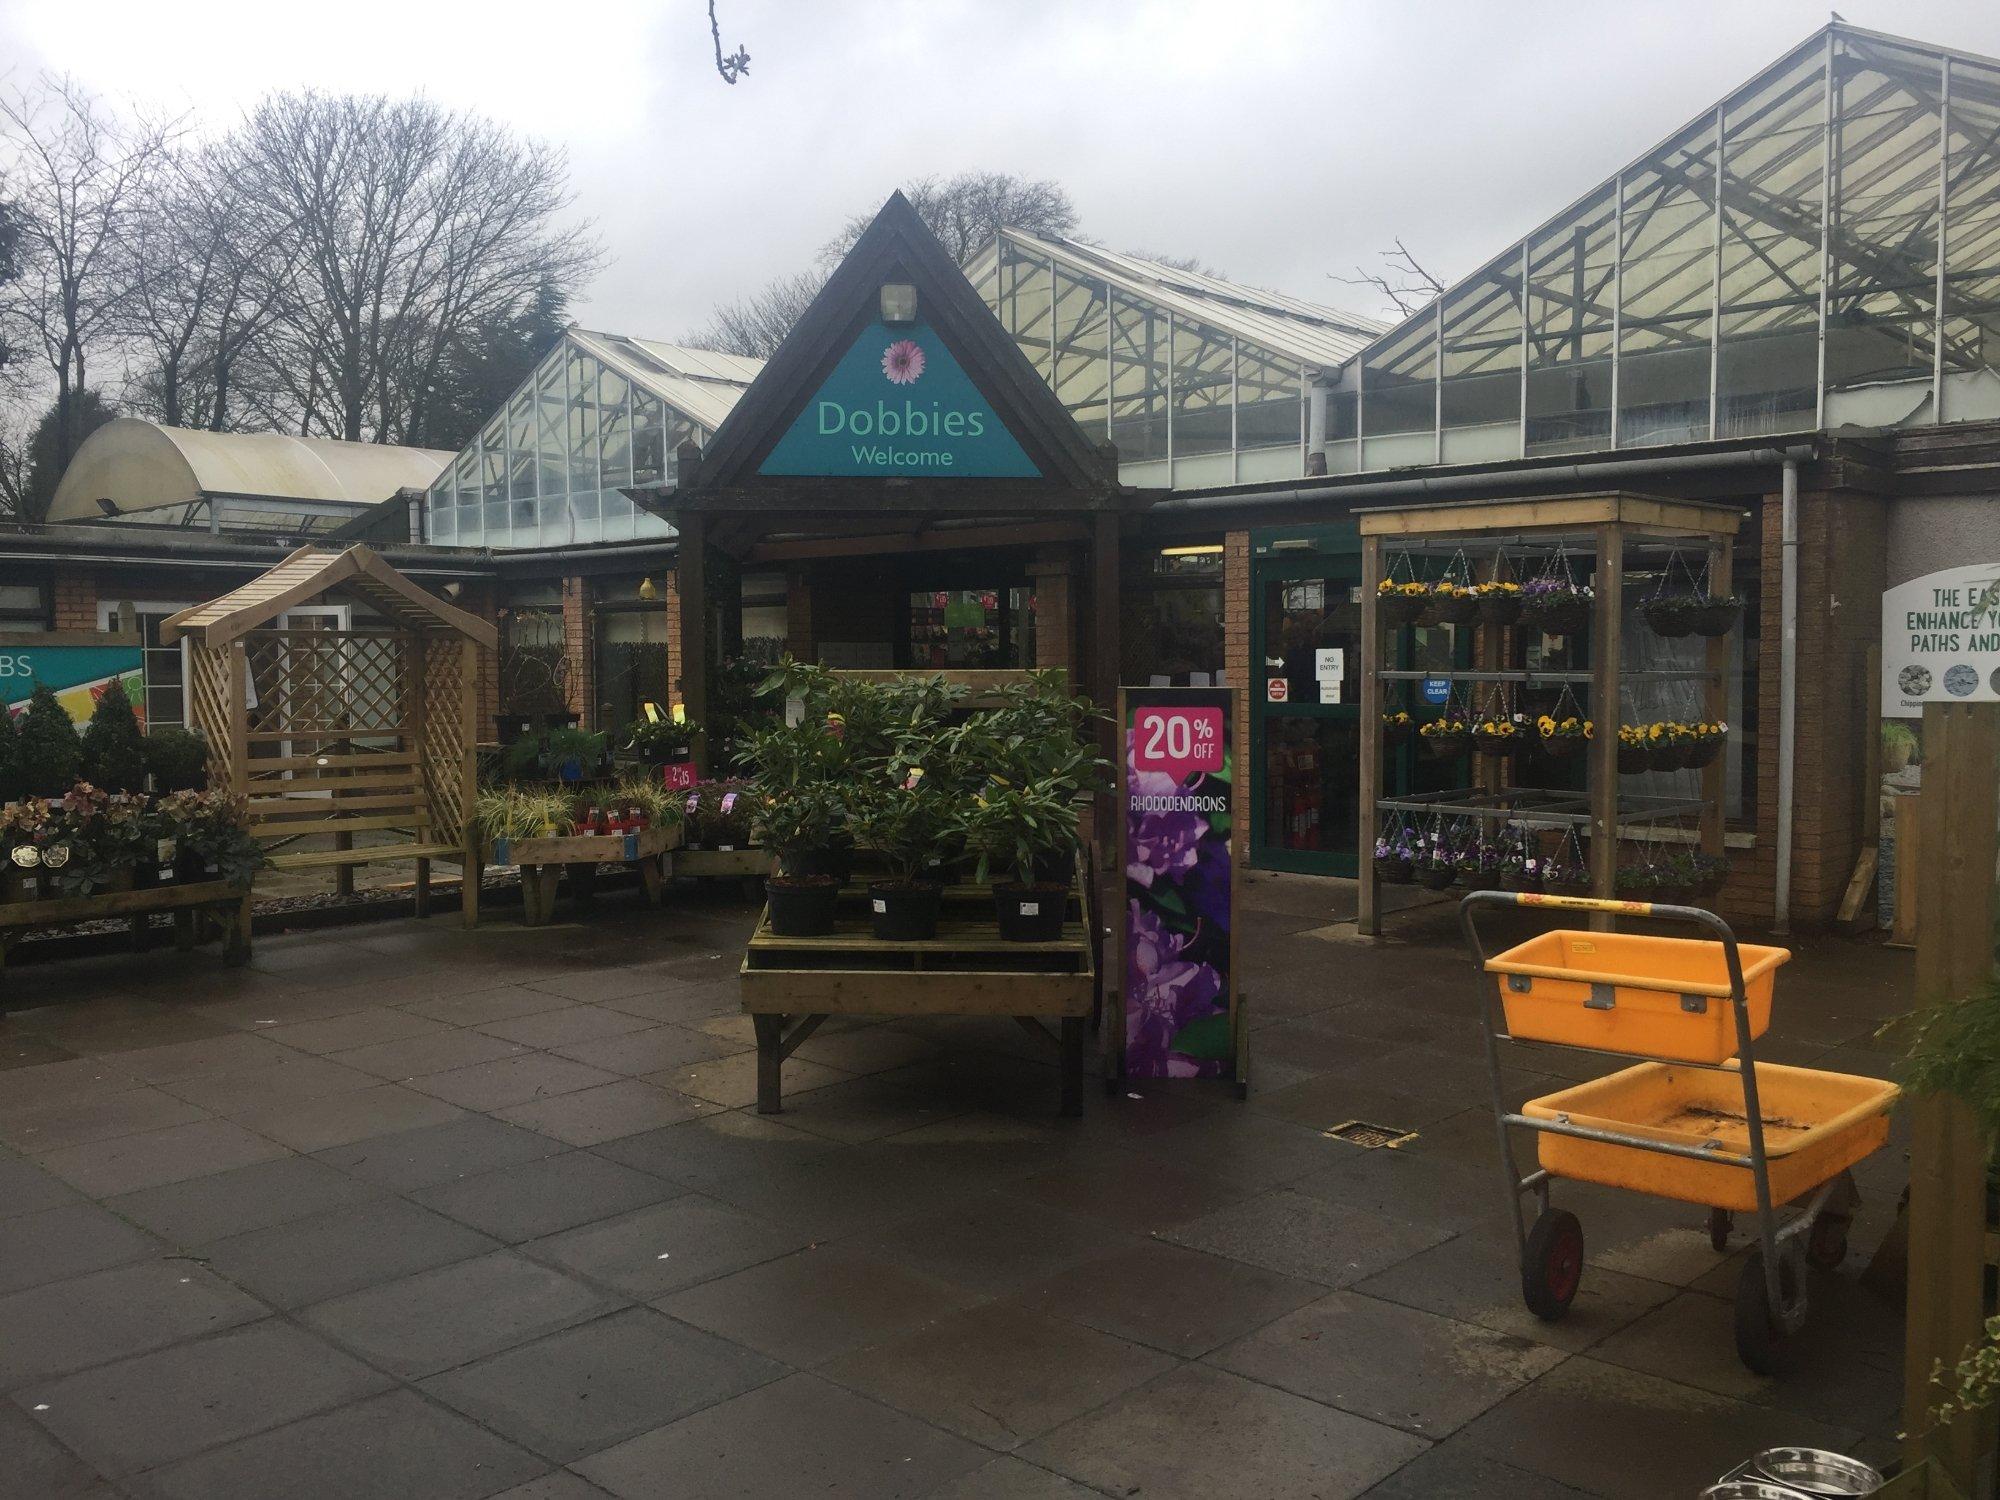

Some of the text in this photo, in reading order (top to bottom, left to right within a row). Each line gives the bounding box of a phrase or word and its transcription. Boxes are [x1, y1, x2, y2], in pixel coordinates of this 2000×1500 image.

[819, 400, 984, 436] Dobbies
[851, 445, 953, 466] Welcome
[1933, 588, 1960, 607] THE
[1907, 611, 1979, 630] ENHANCE
[1911, 633, 2000, 652] PATHS AND
[1193, 743, 1214, 759] OFF
[672, 767, 677, 781] 2
[1130, 795, 1226, 812] RHODODENDRONS
